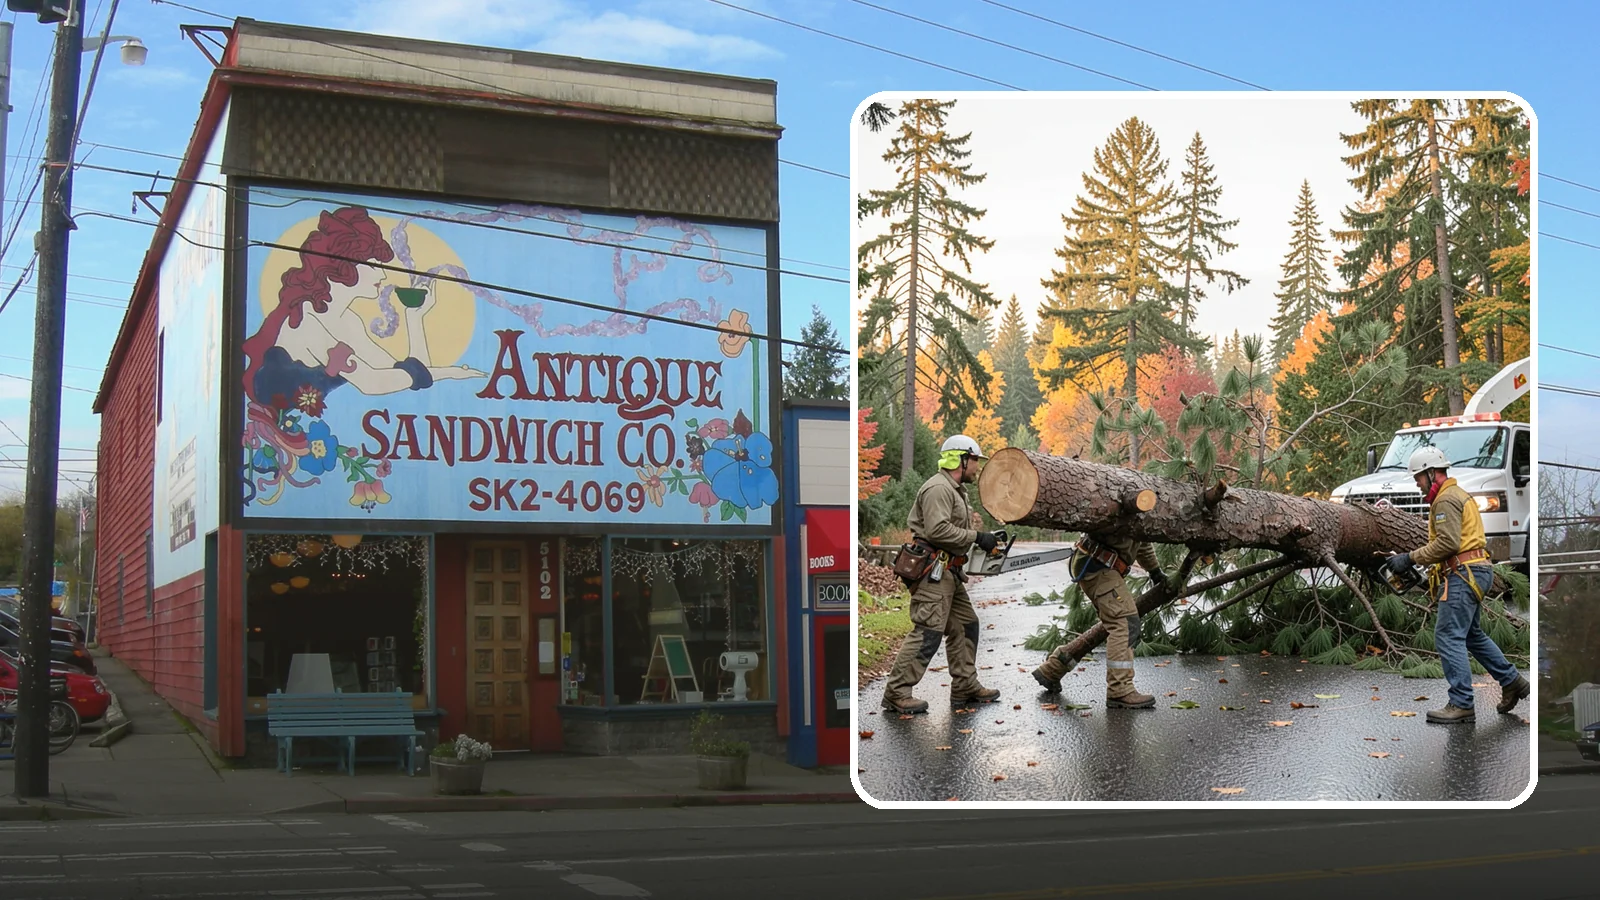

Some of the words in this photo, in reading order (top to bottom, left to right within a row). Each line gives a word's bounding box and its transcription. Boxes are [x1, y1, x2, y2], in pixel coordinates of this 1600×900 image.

[476, 329, 724, 420] ANTIQUE
[361, 408, 604, 467] SANDWICH
[617, 421, 686, 469] CO.
[468, 477, 646, 512] SK2-4069
[539, 541, 552, 600] 5102
[809, 555, 835, 569] BOOKS
